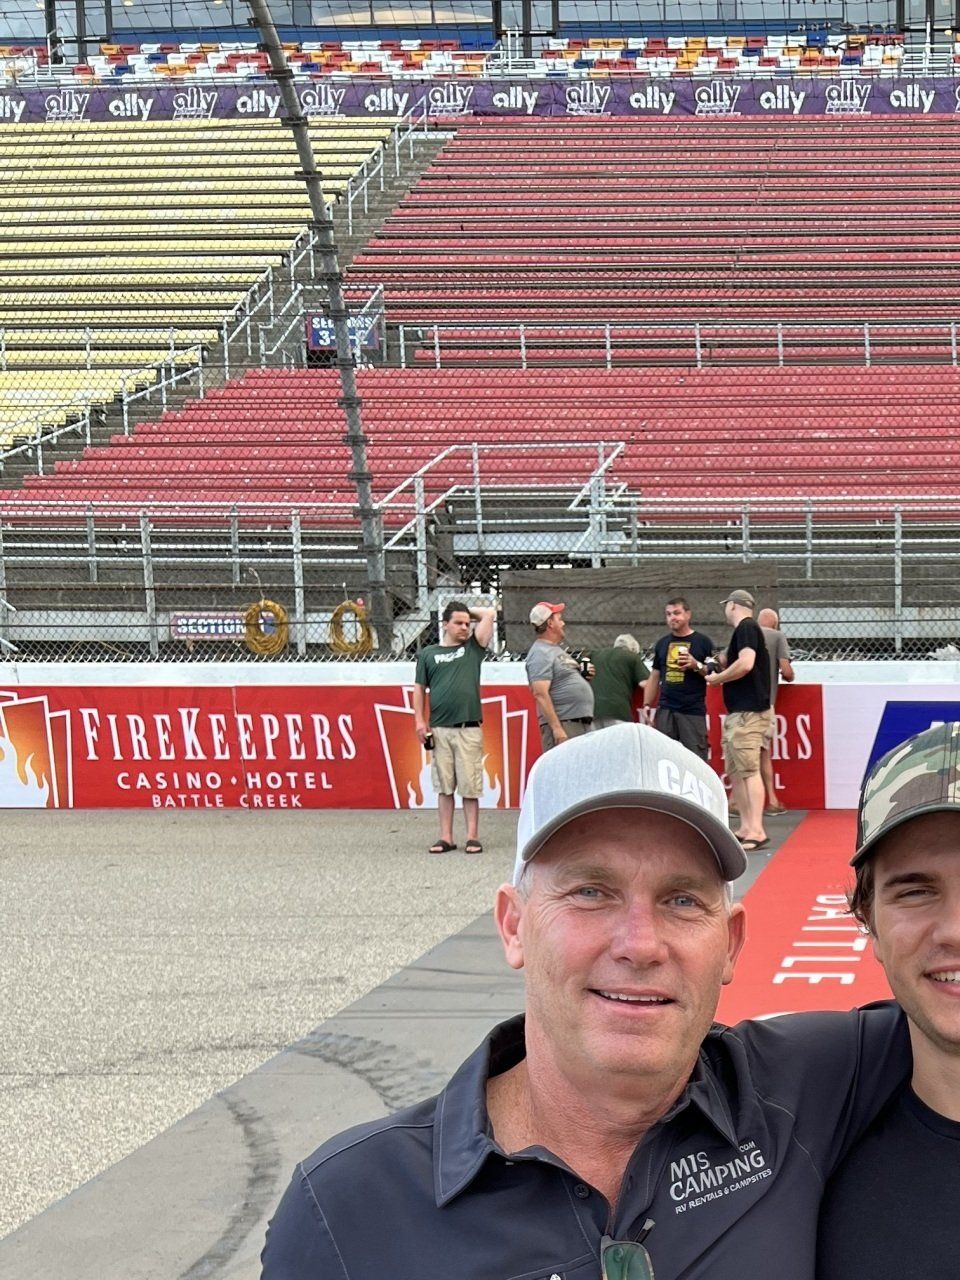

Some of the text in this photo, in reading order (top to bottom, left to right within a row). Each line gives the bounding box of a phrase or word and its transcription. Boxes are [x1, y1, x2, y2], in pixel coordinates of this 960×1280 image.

[0, 95, 26, 122] lly
[108, 93, 153, 120] ally
[236, 90, 281, 117] ally
[364, 87, 409, 114] ally
[492, 86, 538, 114] ally
[629, 86, 675, 114] ally
[695, 81, 740, 115] ally
[760, 85, 805, 114] ally
[825, 79, 871, 114] ally
[889, 84, 935, 113] ally
[79, 708, 357, 760] FIREKEEPERS
[117, 772, 333, 790] CASINO HOTEL
[152, 794, 303, 808] BATTLE CREEK
[657, 758, 714, 810] CAT
[669, 1149, 766, 1201] CAMPING
[670, 1151, 711, 1182] MIS
[675, 1203, 688, 1214] RV
[688, 1189, 723, 1209] RENTALS
[729, 1168, 773, 1192] CAMPSITES
